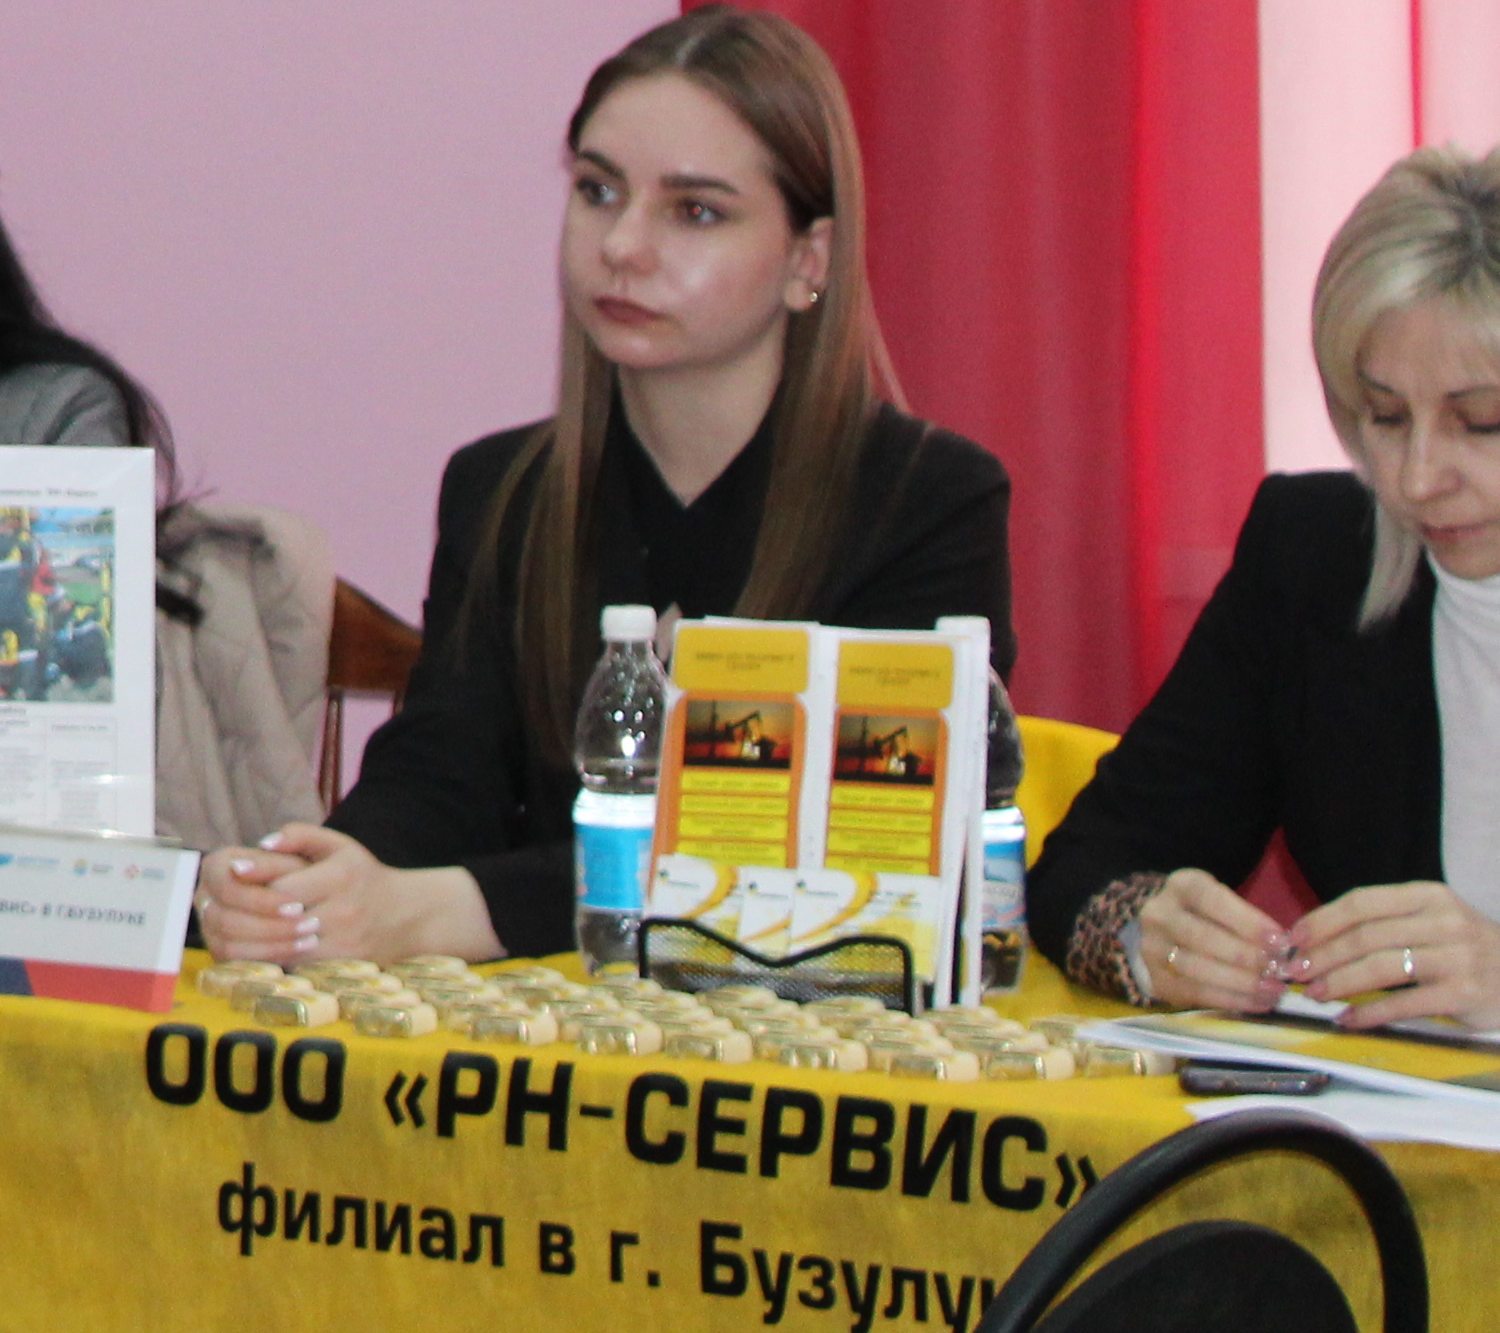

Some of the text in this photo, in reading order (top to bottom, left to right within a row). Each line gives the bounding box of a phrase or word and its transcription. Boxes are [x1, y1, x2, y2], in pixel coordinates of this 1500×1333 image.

[143, 1021, 1100, 1212] ООО «РН-СЕРВИС»
[217, 1162, 506, 1270] филиал
[537, 1221, 576, 1277] в
[608, 1229, 663, 1288] г.
